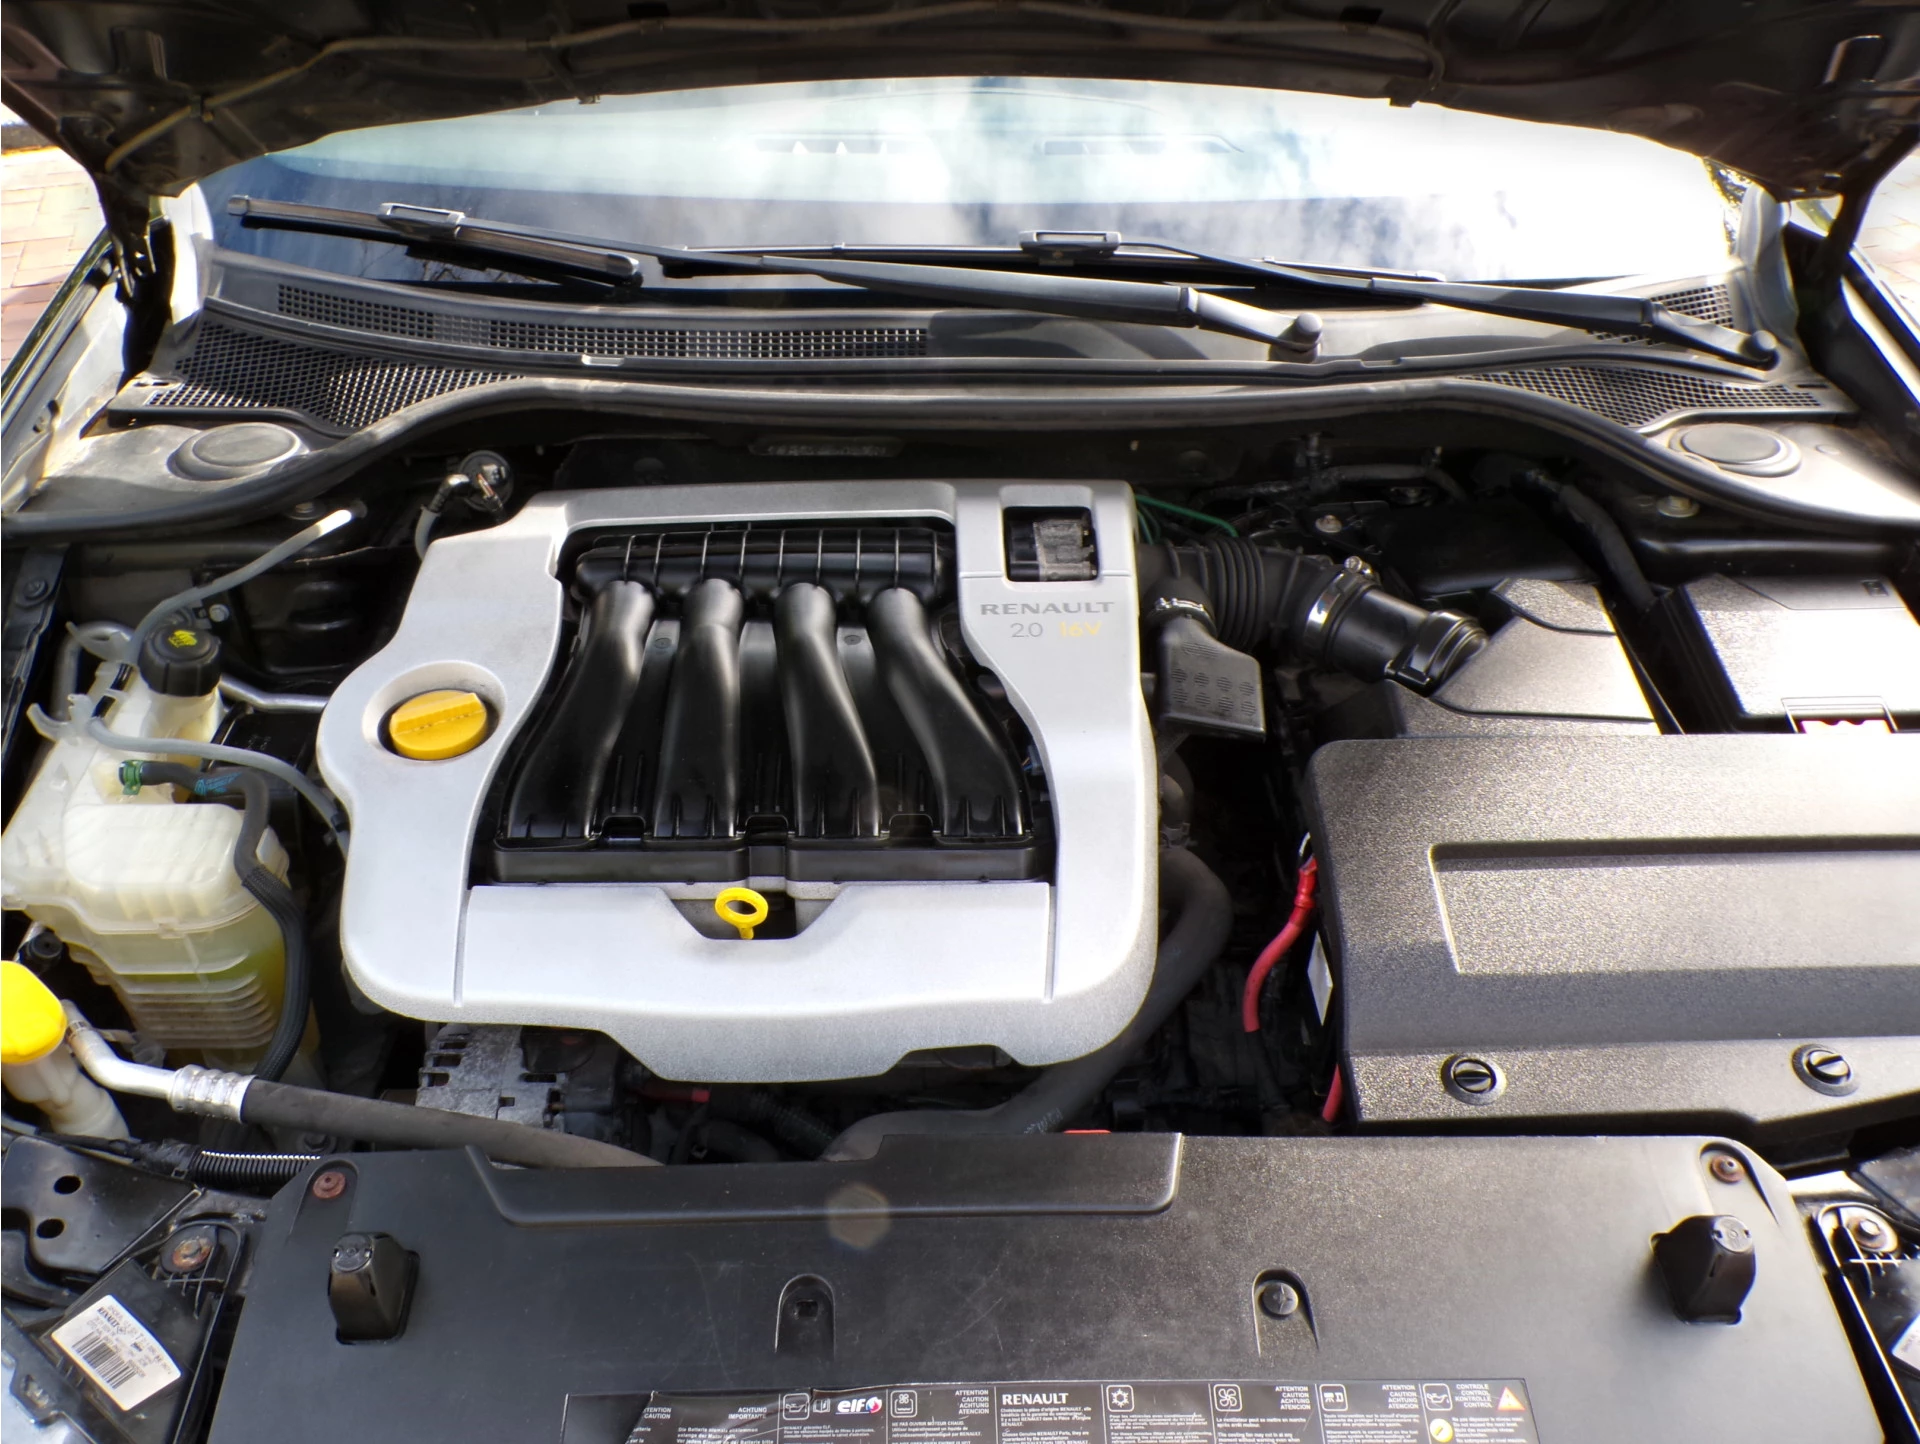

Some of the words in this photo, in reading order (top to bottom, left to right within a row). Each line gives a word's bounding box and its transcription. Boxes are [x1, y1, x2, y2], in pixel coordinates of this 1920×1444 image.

[980, 601, 1115, 615] RENAULT
[1010, 622, 1043, 638] 2.0
[1058, 621, 1102, 637] 16V
[837, 1398, 866, 1412] elf
[1002, 1393, 1068, 1405] RENAULT
